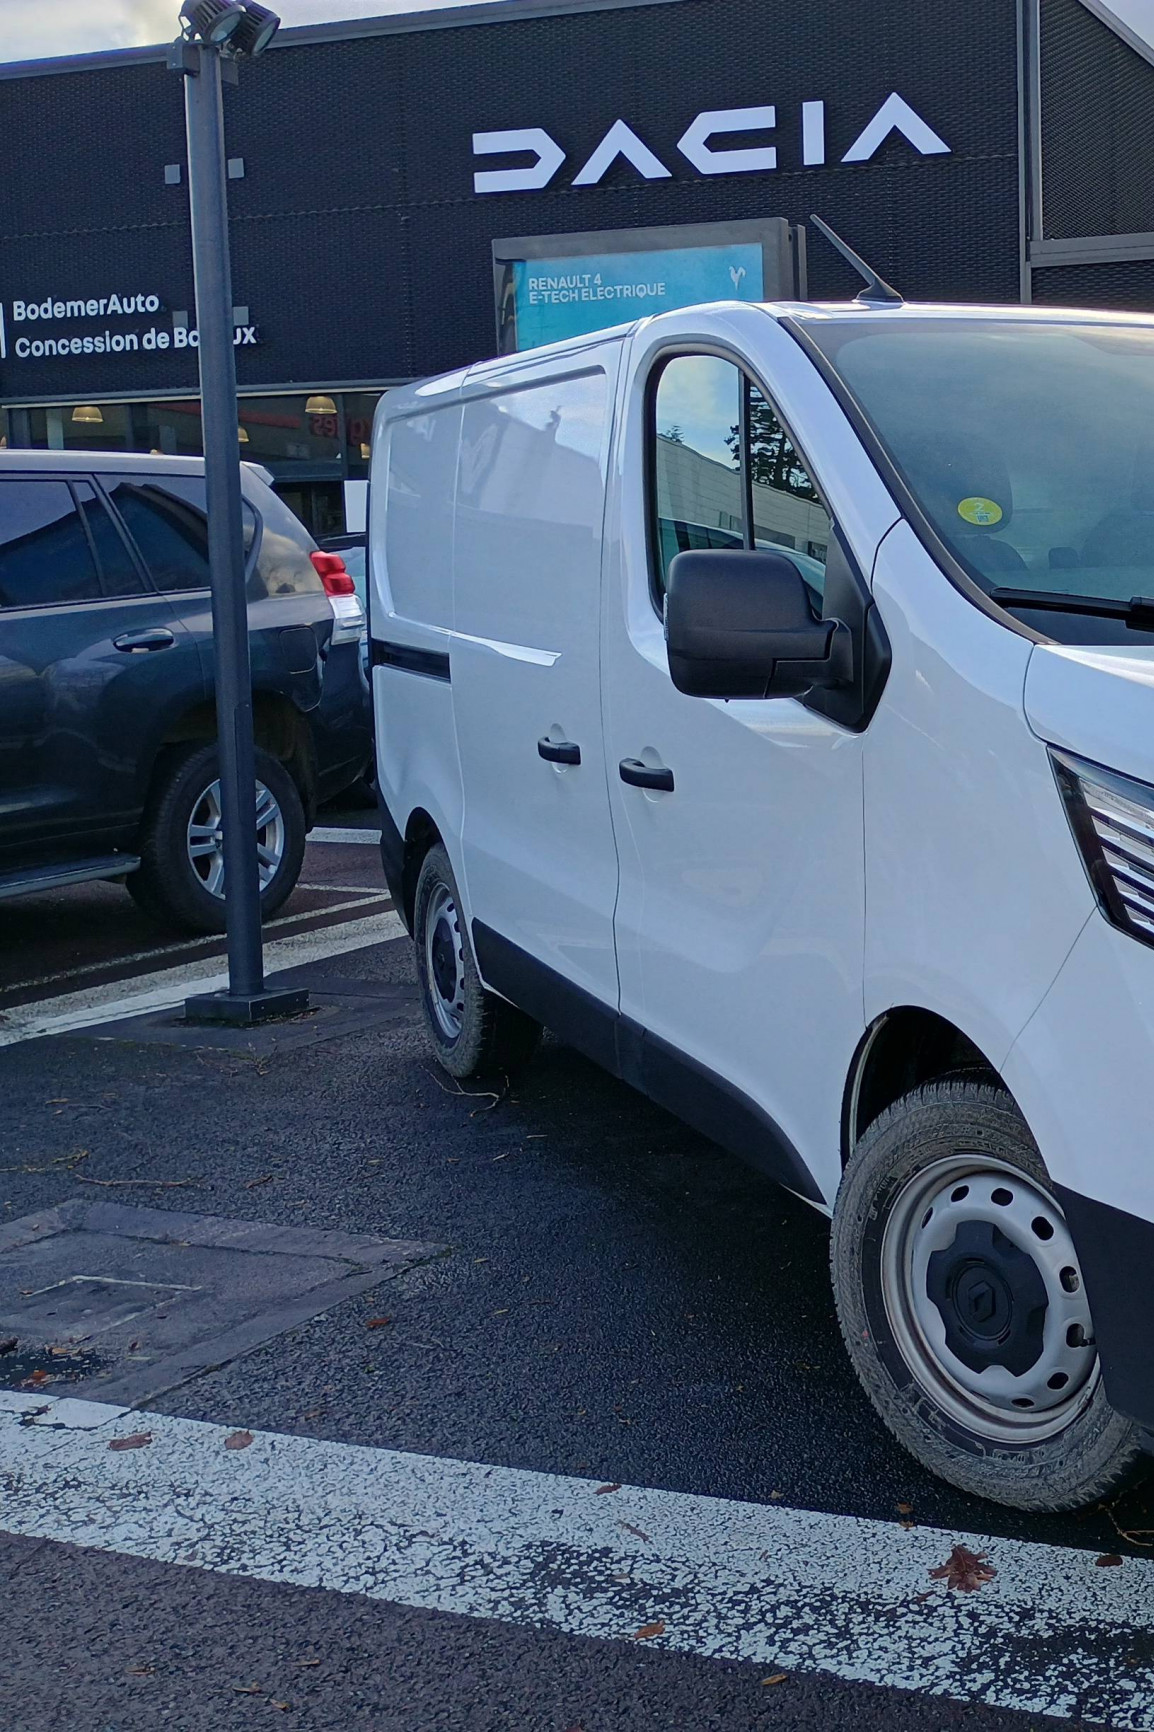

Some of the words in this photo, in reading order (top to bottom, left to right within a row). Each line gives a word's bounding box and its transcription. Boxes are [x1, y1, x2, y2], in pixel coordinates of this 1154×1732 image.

[472, 91, 952, 194] DACIA
[528, 274, 591, 290] RENAULT
[593, 273, 602, 286] 4
[529, 289, 578, 304] E-TECH
[581, 283, 666, 301] ELECTRIQUE
[13, 293, 160, 321] BodemerAuto
[15, 330, 139, 358] Concession
[142, 328, 170, 350] de
